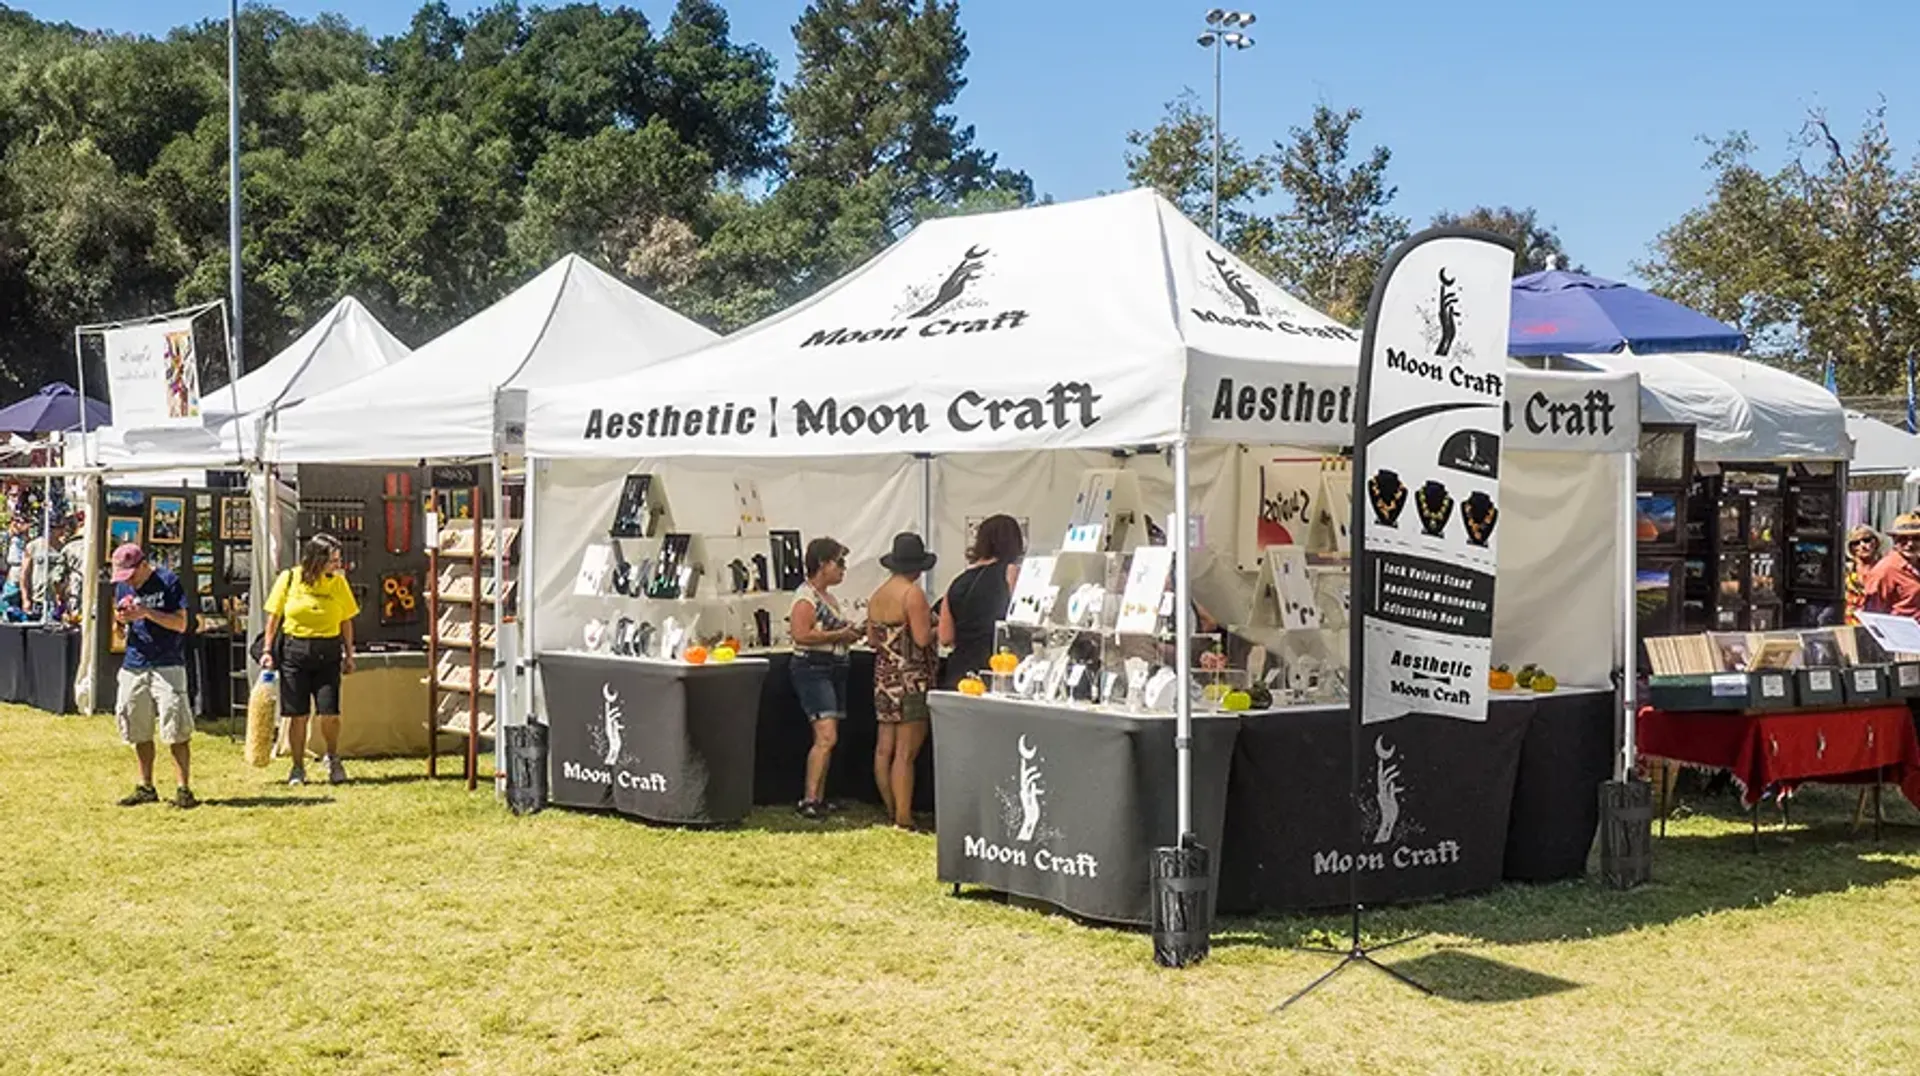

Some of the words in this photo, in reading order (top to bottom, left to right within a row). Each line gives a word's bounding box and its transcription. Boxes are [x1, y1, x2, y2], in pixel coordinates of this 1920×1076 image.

[799, 326, 908, 348] Moon
[919, 310, 1029, 337] Craft
[1191, 308, 1273, 332] Moon
[1277, 321, 1358, 342] Craft
[1386, 347, 1443, 381] Moon
[1449, 365, 1503, 397] Craft
[583, 402, 757, 440] Aesthetic
[792, 396, 930, 437] Moon
[947, 381, 1102, 432] Craft
[1211, 378, 1357, 424] Aesthet
[1524, 389, 1615, 435] Craft
[1391, 650, 1472, 678] Aesthetic
[1391, 680, 1430, 698] Moon
[1434, 687, 1471, 705] Craft
[563, 761, 612, 784] Moon
[617, 770, 667, 793] Craft
[964, 835, 1027, 866] Moon
[1034, 849, 1098, 878] Craft
[1313, 850, 1385, 875] Moon
[1393, 840, 1460, 868] Craft
